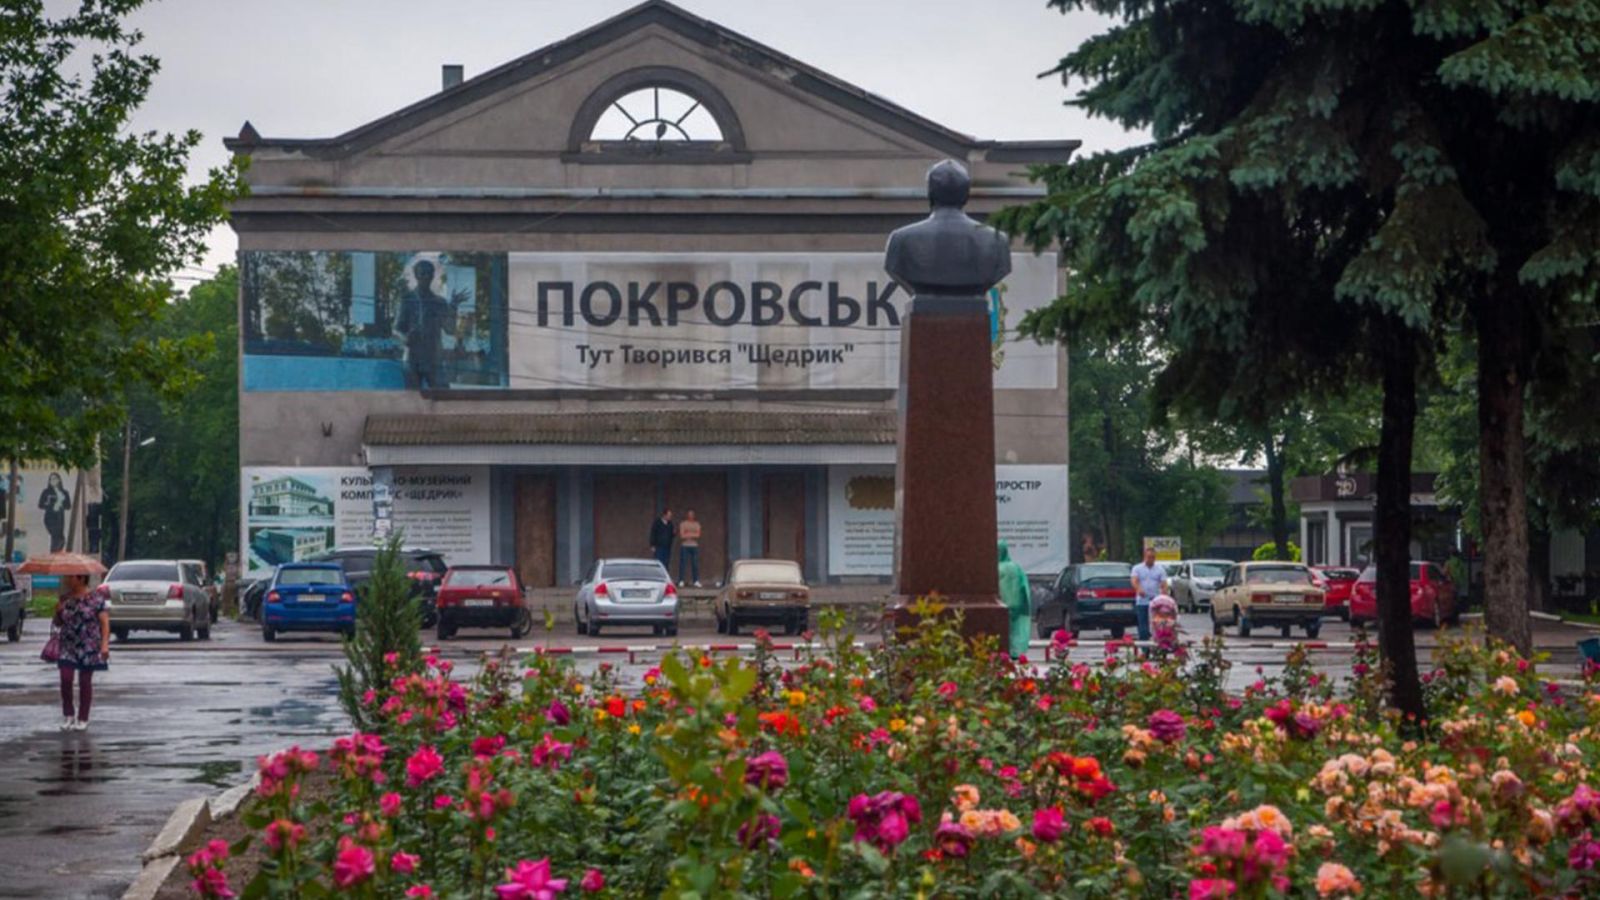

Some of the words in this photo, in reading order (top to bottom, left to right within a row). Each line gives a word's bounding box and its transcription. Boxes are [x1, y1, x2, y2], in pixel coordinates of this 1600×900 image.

[537, 280, 900, 327] ПОКРОВСЬК
[576, 345, 614, 368] Тут
[620, 345, 731, 368] Творився
[738, 344, 854, 367] "Щедрик"
[340, 474, 472, 486] КУЛЬО-МУЗЕЙНИЙ
[340, 489, 402, 500] КОМПС
